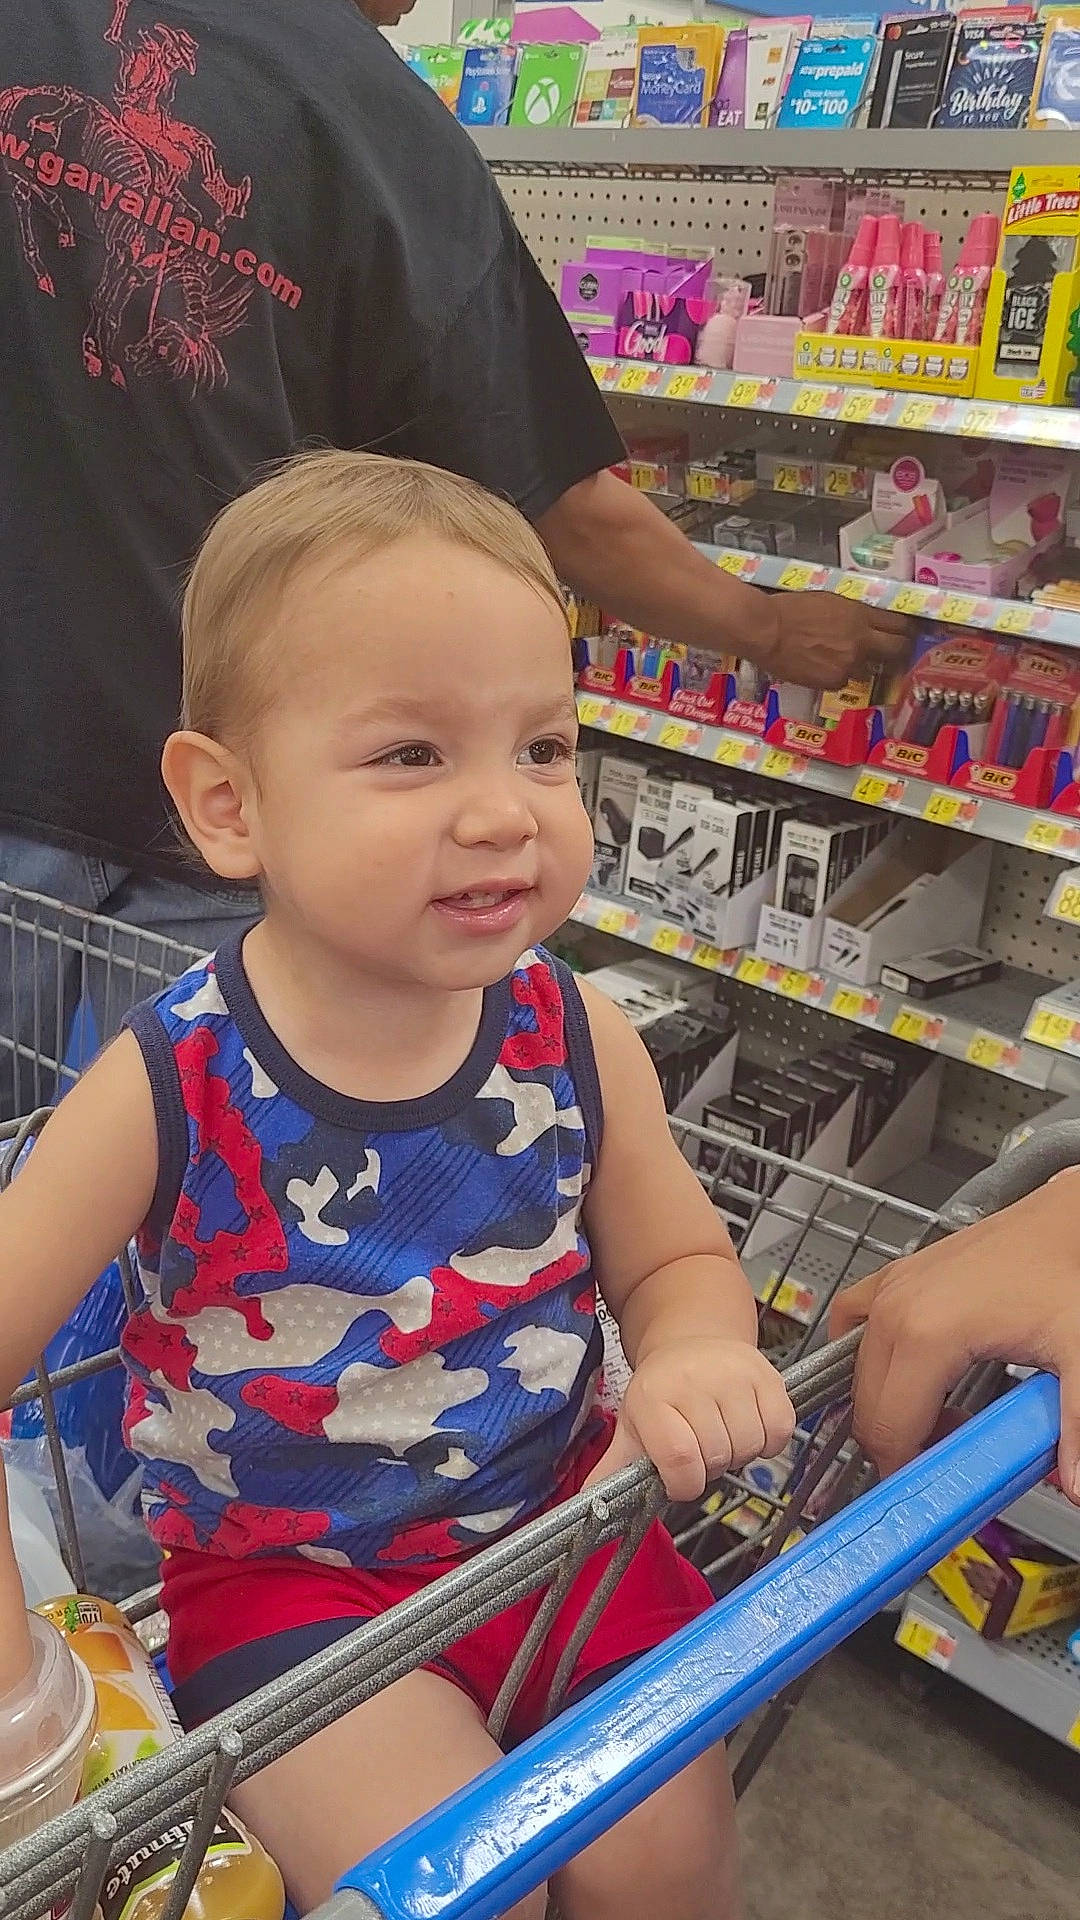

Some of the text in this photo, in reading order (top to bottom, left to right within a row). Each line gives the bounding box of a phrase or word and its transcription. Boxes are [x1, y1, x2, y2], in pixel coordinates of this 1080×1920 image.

[963, 31, 985, 40] VISA
[814, 62, 865, 81] prepaid
[972, 66, 1016, 84] HAPPY
[640, 77, 702, 98] MoneyCard
[949, 83, 1023, 121] Birthday
[717, 109, 743, 127] EAT
[1007, 187, 1080, 225] Little Trees
